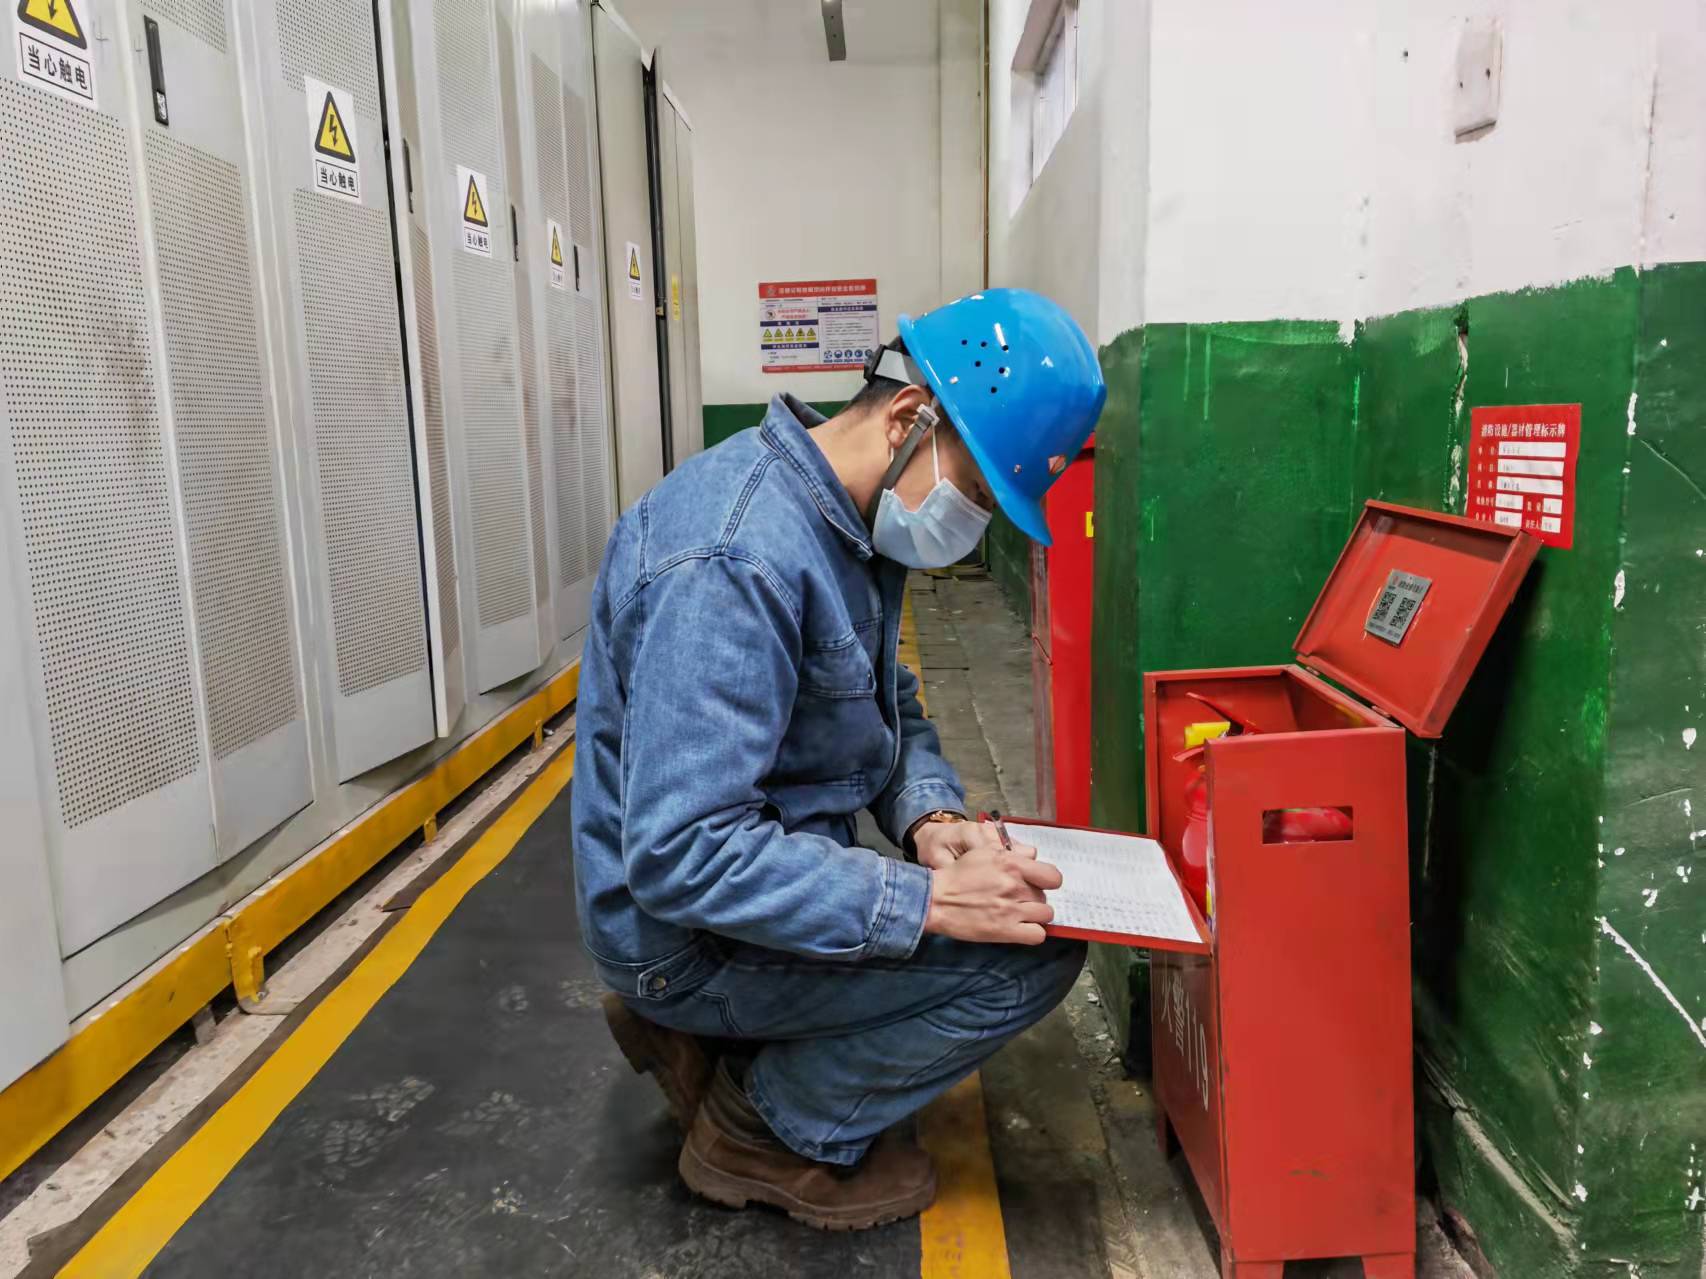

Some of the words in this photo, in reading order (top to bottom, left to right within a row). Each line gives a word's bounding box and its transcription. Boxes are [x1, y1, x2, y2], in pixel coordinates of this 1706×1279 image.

[28, 45, 88, 91] 当心触电
[320, 166, 356, 193] 当心触电
